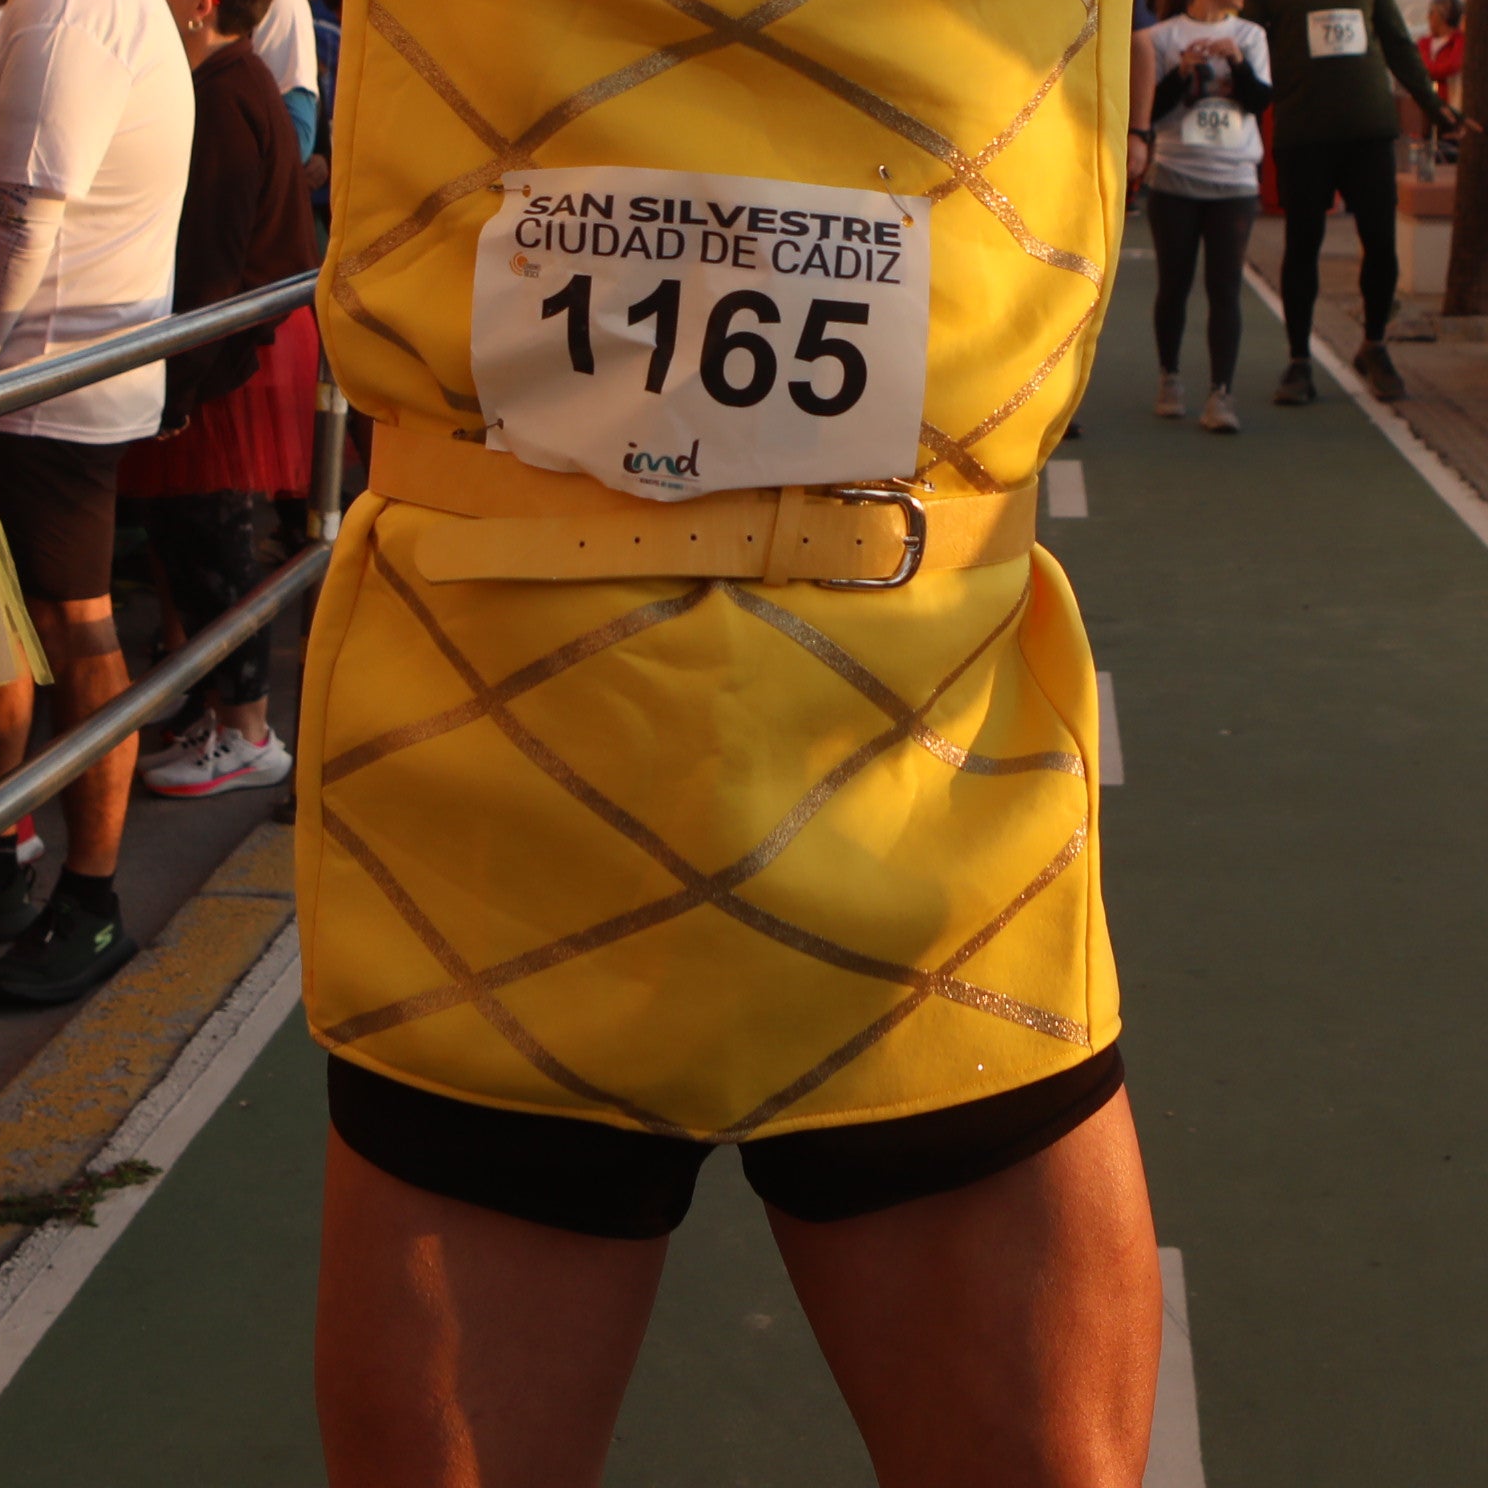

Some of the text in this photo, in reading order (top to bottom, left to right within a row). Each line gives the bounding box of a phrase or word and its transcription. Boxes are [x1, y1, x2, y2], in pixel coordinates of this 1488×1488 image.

[515, 217, 902, 285] CIUDAD DE CÁDIZ
[523, 193, 902, 248] SAN SILVESTRE
[541, 273, 870, 417] 1165
